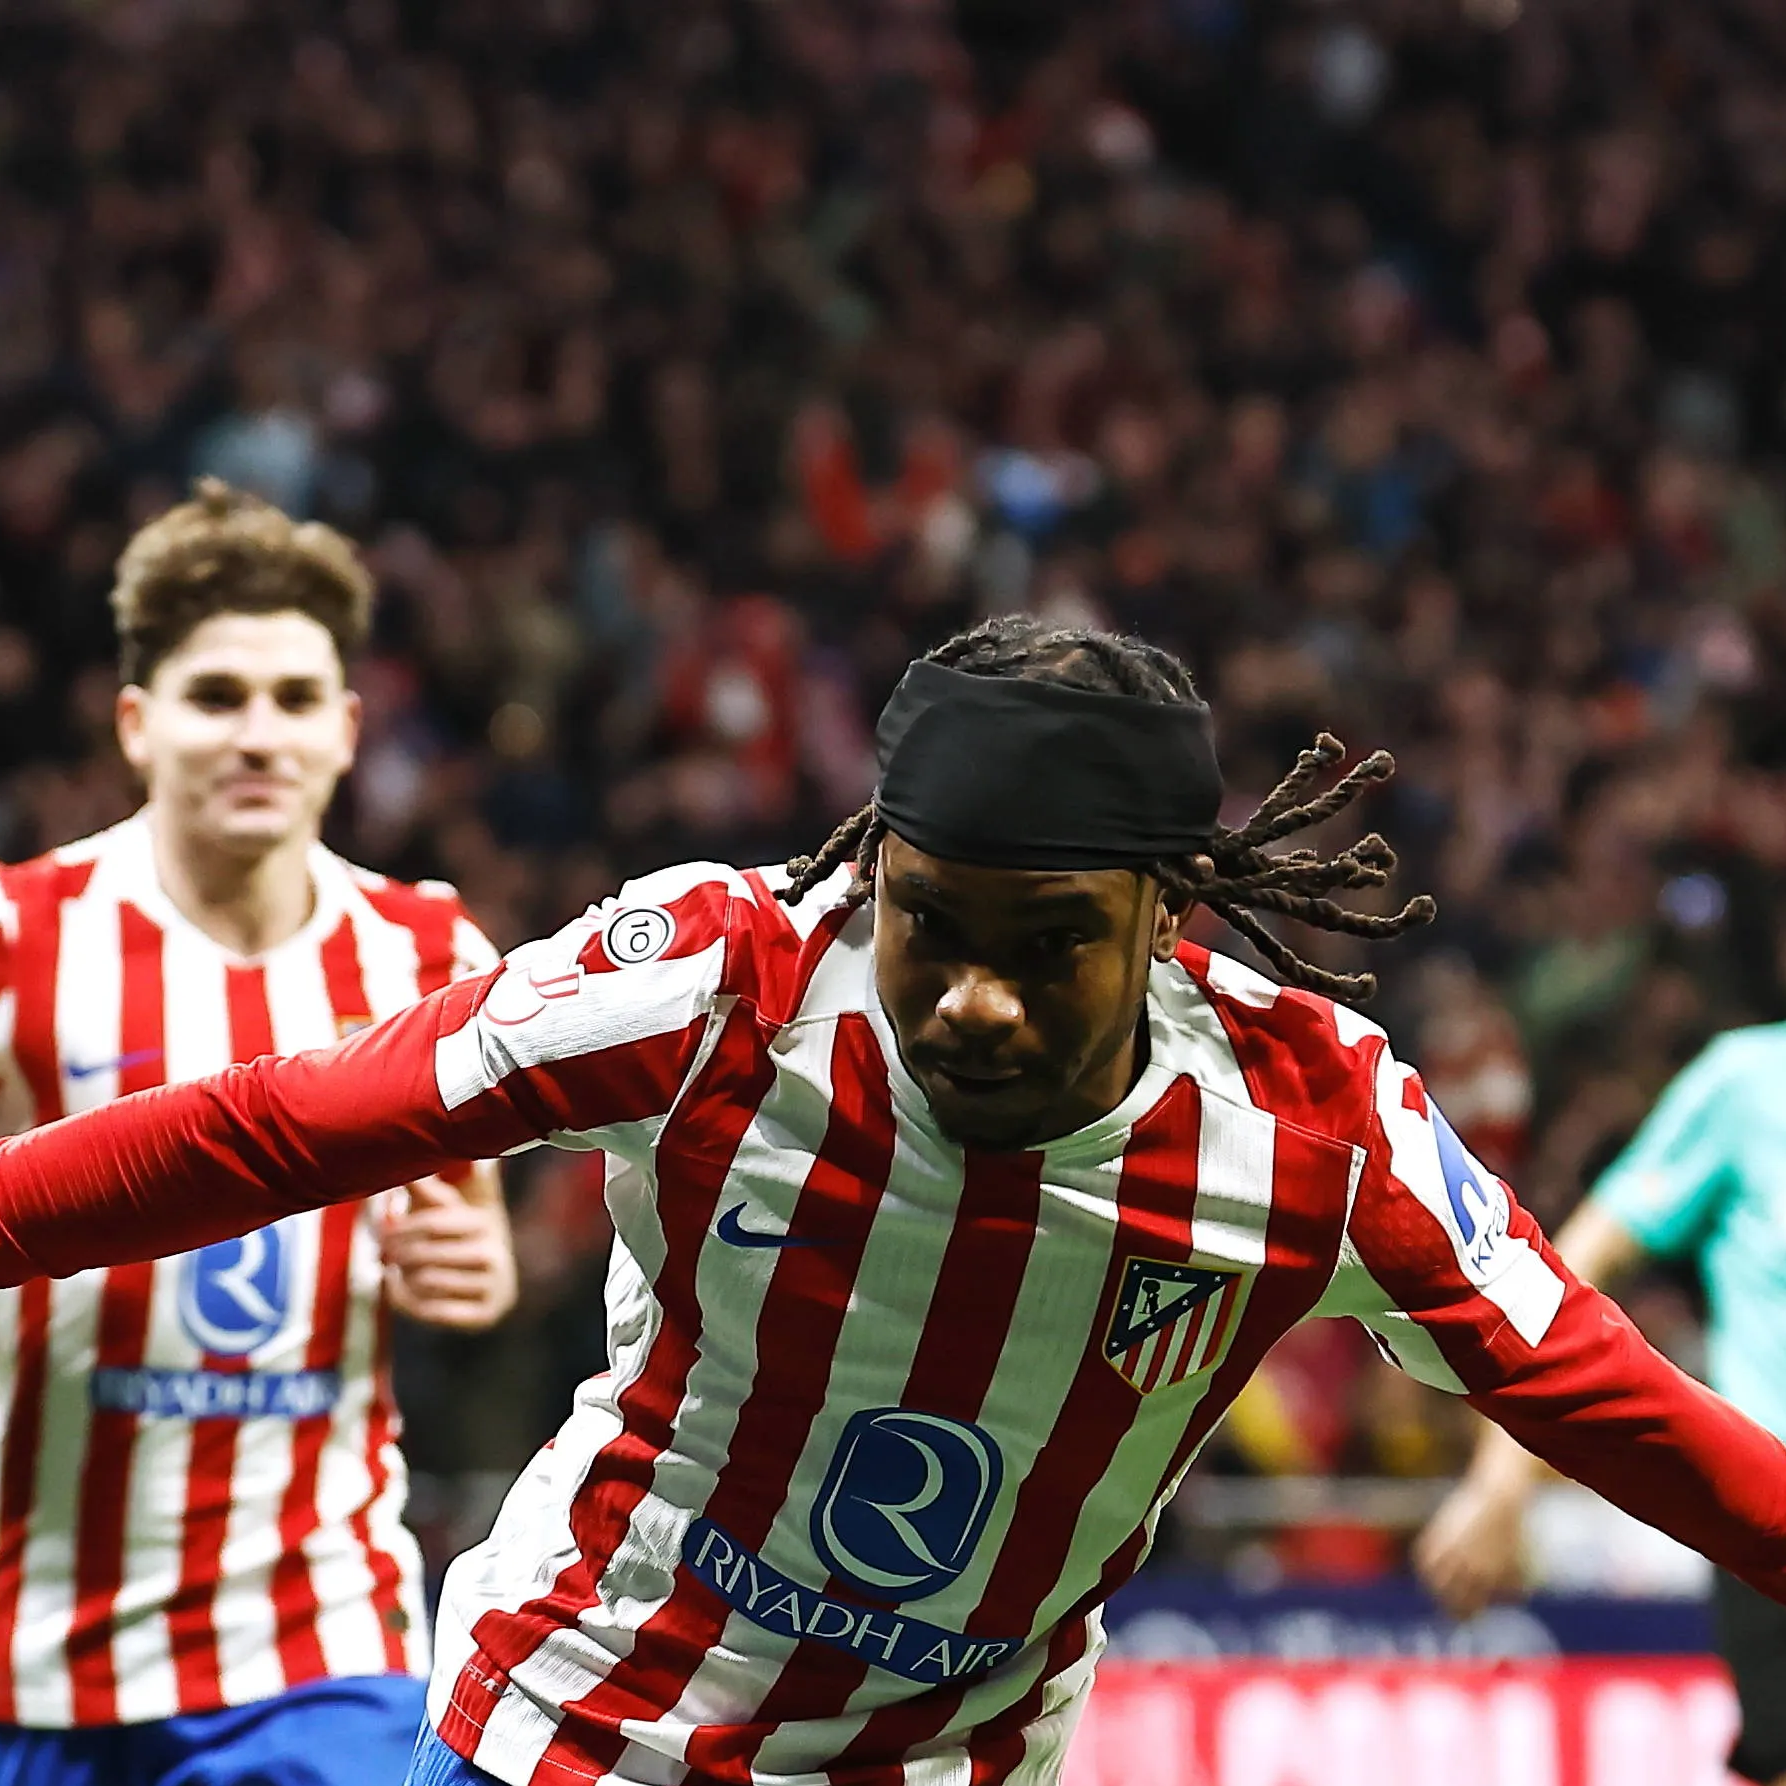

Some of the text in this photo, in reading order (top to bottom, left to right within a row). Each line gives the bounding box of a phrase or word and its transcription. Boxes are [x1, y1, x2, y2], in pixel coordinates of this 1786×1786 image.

[629, 919, 650, 953] 10
[1470, 1192, 1507, 1276] kra
[694, 1528, 905, 1661] RIYADH
[910, 1639, 1010, 1677] AIR
